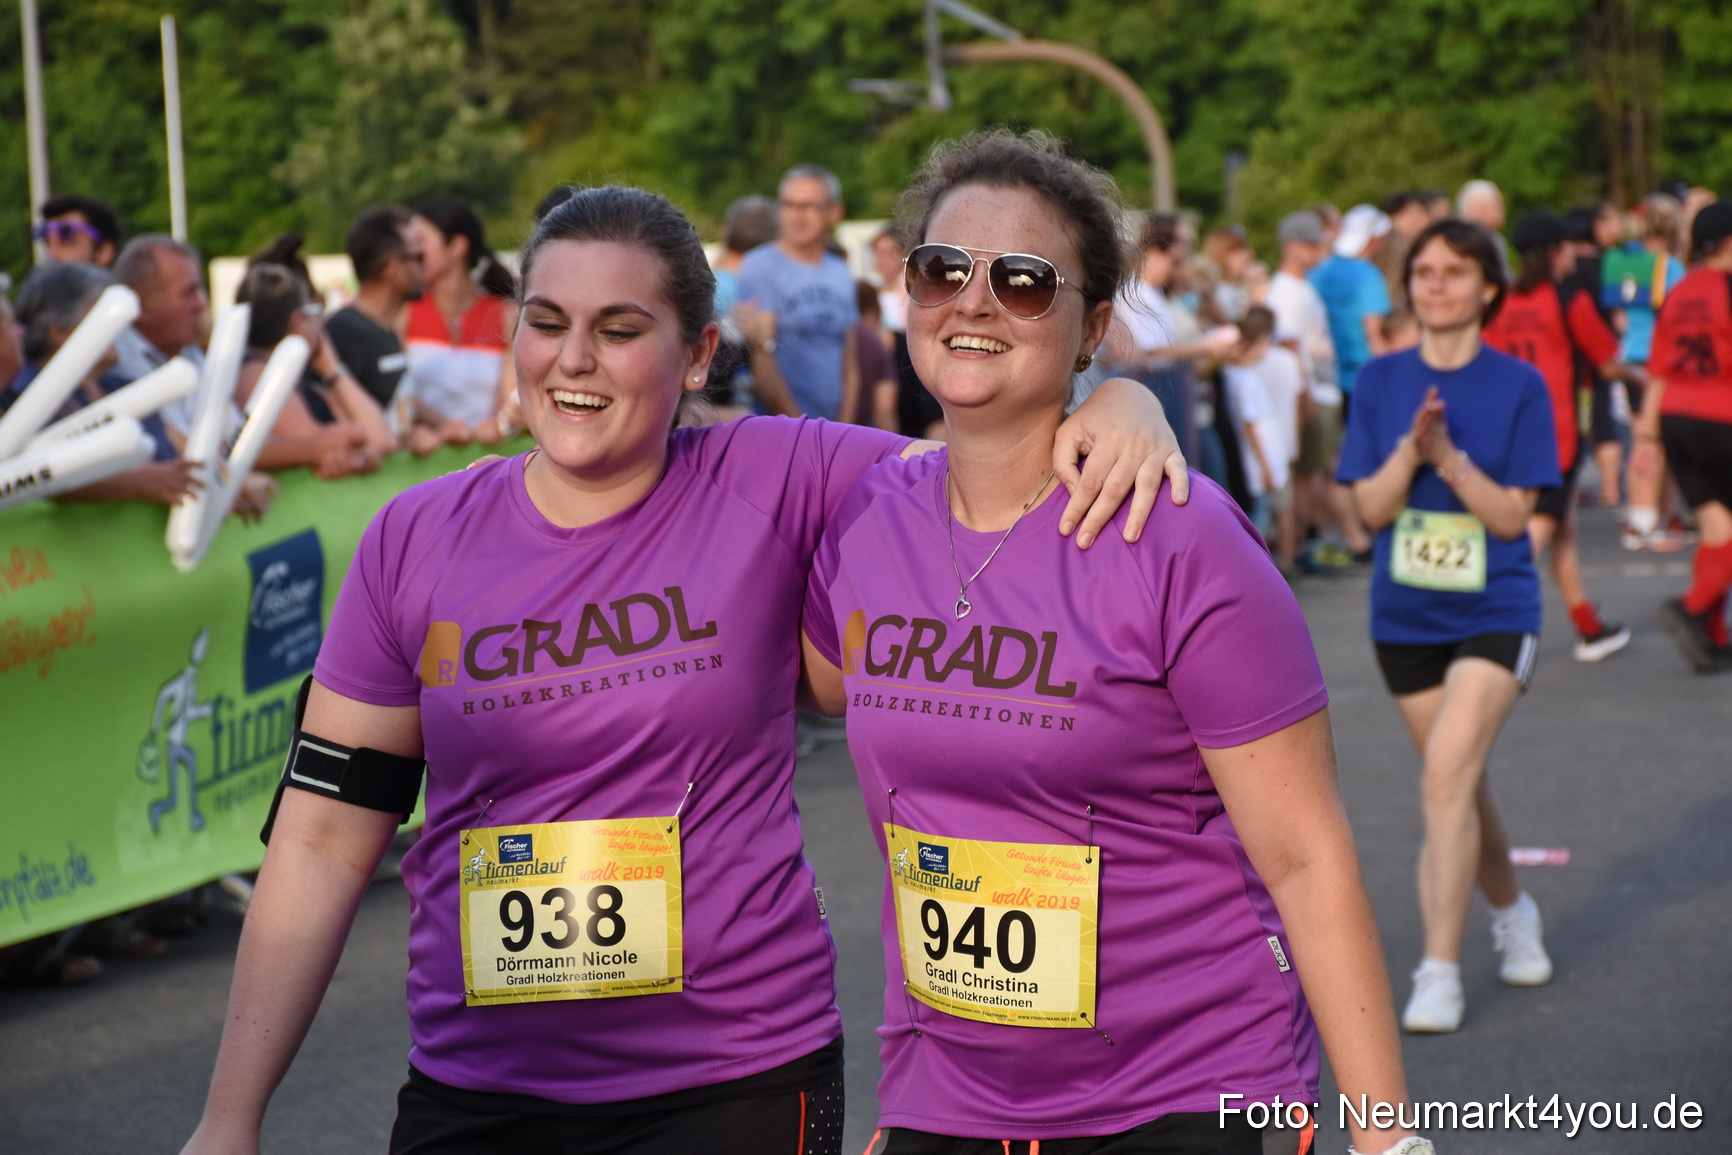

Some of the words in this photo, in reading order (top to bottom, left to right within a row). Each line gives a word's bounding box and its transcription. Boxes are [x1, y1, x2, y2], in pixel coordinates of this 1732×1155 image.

[1403, 540, 1472, 568] 1422
[463, 586, 718, 682] GRADL
[864, 614, 1077, 698] GRADL
[462, 654, 724, 715] HOLZKREATIONEN
[853, 693, 1076, 731] HOLZKREATIONEN
[591, 825, 630, 838] Gesunde
[632, 829, 664, 841] Firmen
[504, 842, 528, 850] Fischer
[608, 838, 636, 851] laufen
[639, 841, 673, 857] länger!
[923, 851, 944, 860] Fischer
[485, 856, 568, 878] firmenlauf
[579, 861, 619, 881] walk
[623, 865, 665, 880] 2019
[1006, 848, 1048, 864] Gesunde
[1049, 856, 1083, 871] Firmen
[486, 877, 519, 885] neumarkt
[909, 863, 983, 892] firmenlauf
[910, 881, 936, 893] neumarkt
[1023, 863, 1053, 878] laufen
[1055, 869, 1091, 887] länger!
[991, 887, 1034, 907] walk
[1036, 894, 1081, 910] 2019
[499, 884, 627, 952] 938
[920, 899, 1037, 973] 940
[496, 955, 576, 973] Dörrmann
[582, 949, 638, 968] Nicole
[506, 973, 534, 986] Gradl
[537, 970, 625, 984] Holzkreationen
[925, 962, 957, 984] Gradl
[962, 971, 1039, 994] Christina
[929, 980, 950, 997] Gradl
[951, 988, 1033, 1009] Holzkreationen
